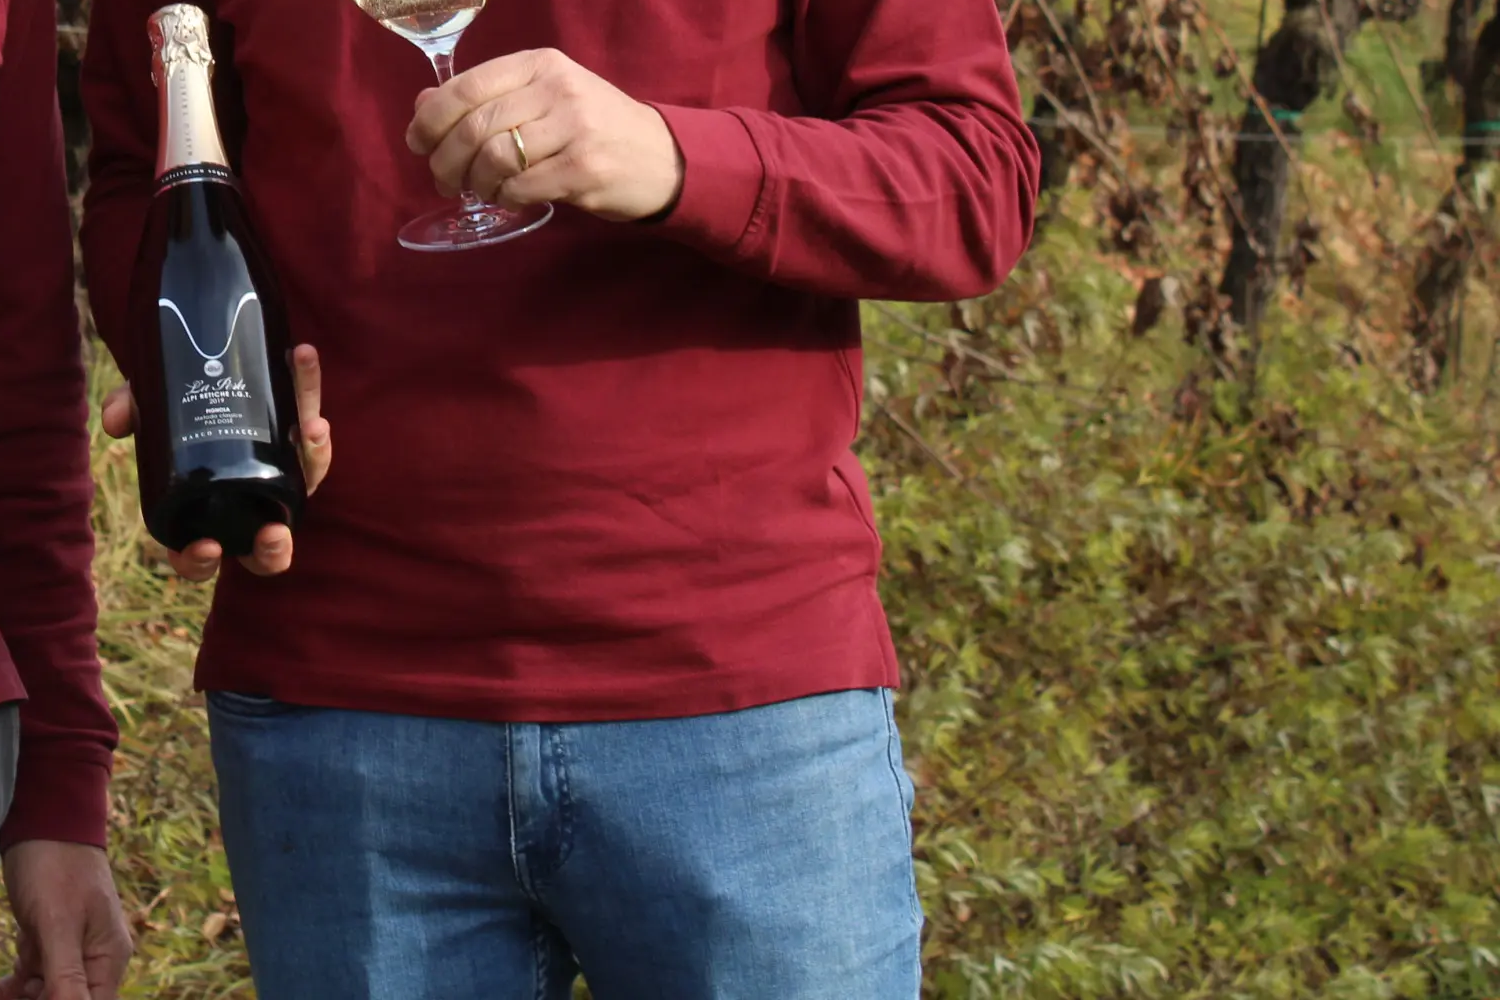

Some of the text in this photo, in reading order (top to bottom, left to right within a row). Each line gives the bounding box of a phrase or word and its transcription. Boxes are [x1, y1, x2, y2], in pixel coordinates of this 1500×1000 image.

[182, 395, 198, 404] ALPI
[200, 391, 230, 399] RETICHE
[181, 428, 259, 442] MARCO TRIACCA
